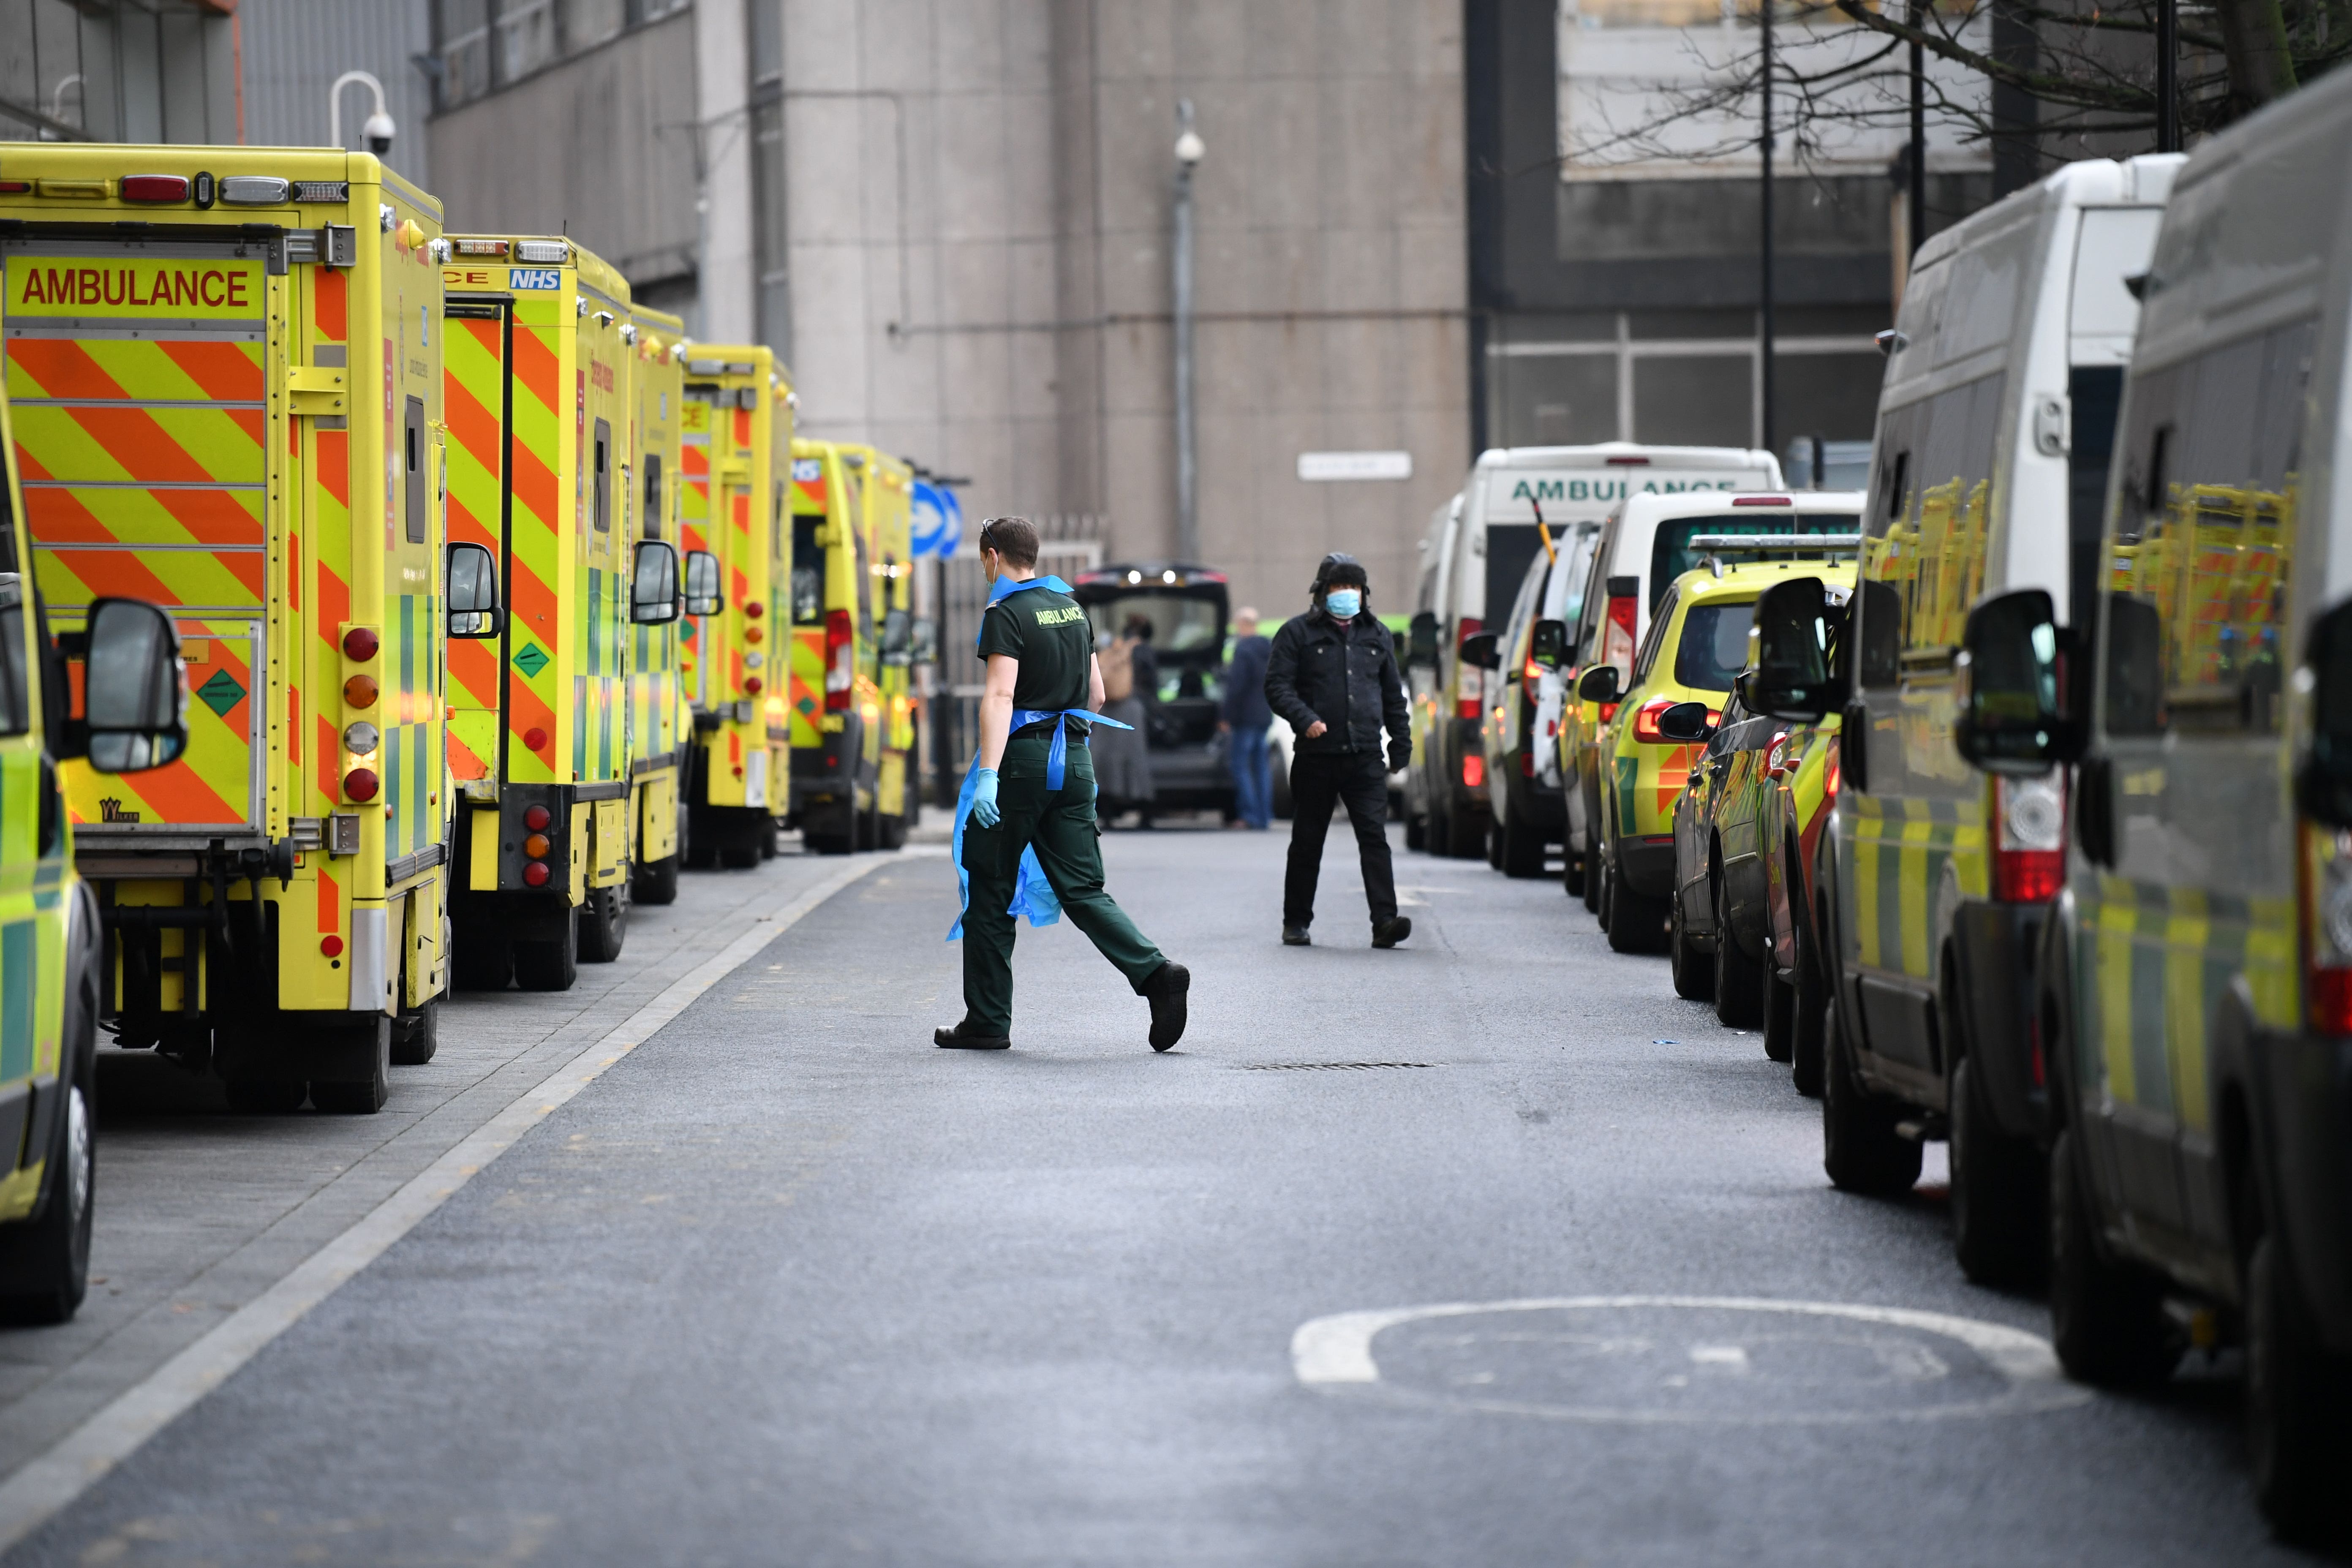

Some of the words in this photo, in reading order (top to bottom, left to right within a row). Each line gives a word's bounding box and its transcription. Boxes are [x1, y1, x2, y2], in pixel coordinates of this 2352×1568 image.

[22, 269, 248, 307] AMBULANCE
[510, 270, 559, 289] NHS
[1035, 606, 1085, 626] AMBULANCE
